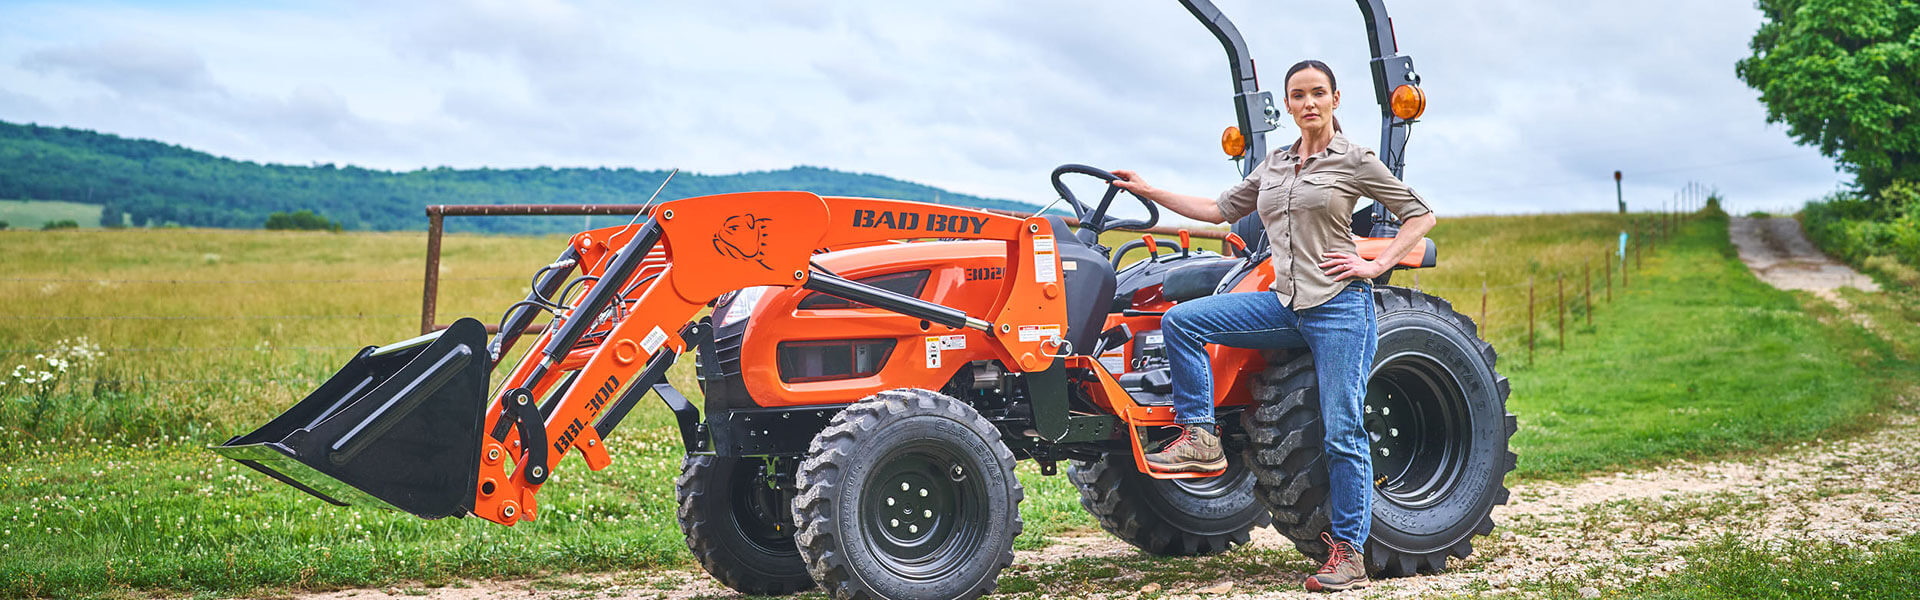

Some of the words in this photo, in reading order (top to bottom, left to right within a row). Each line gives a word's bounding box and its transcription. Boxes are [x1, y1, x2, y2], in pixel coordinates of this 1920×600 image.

[853, 209, 919, 230] BAD
[926, 213, 989, 234] BOY
[966, 266, 1006, 281] 302
[553, 418, 589, 455] BBL
[584, 374, 620, 413] 300
